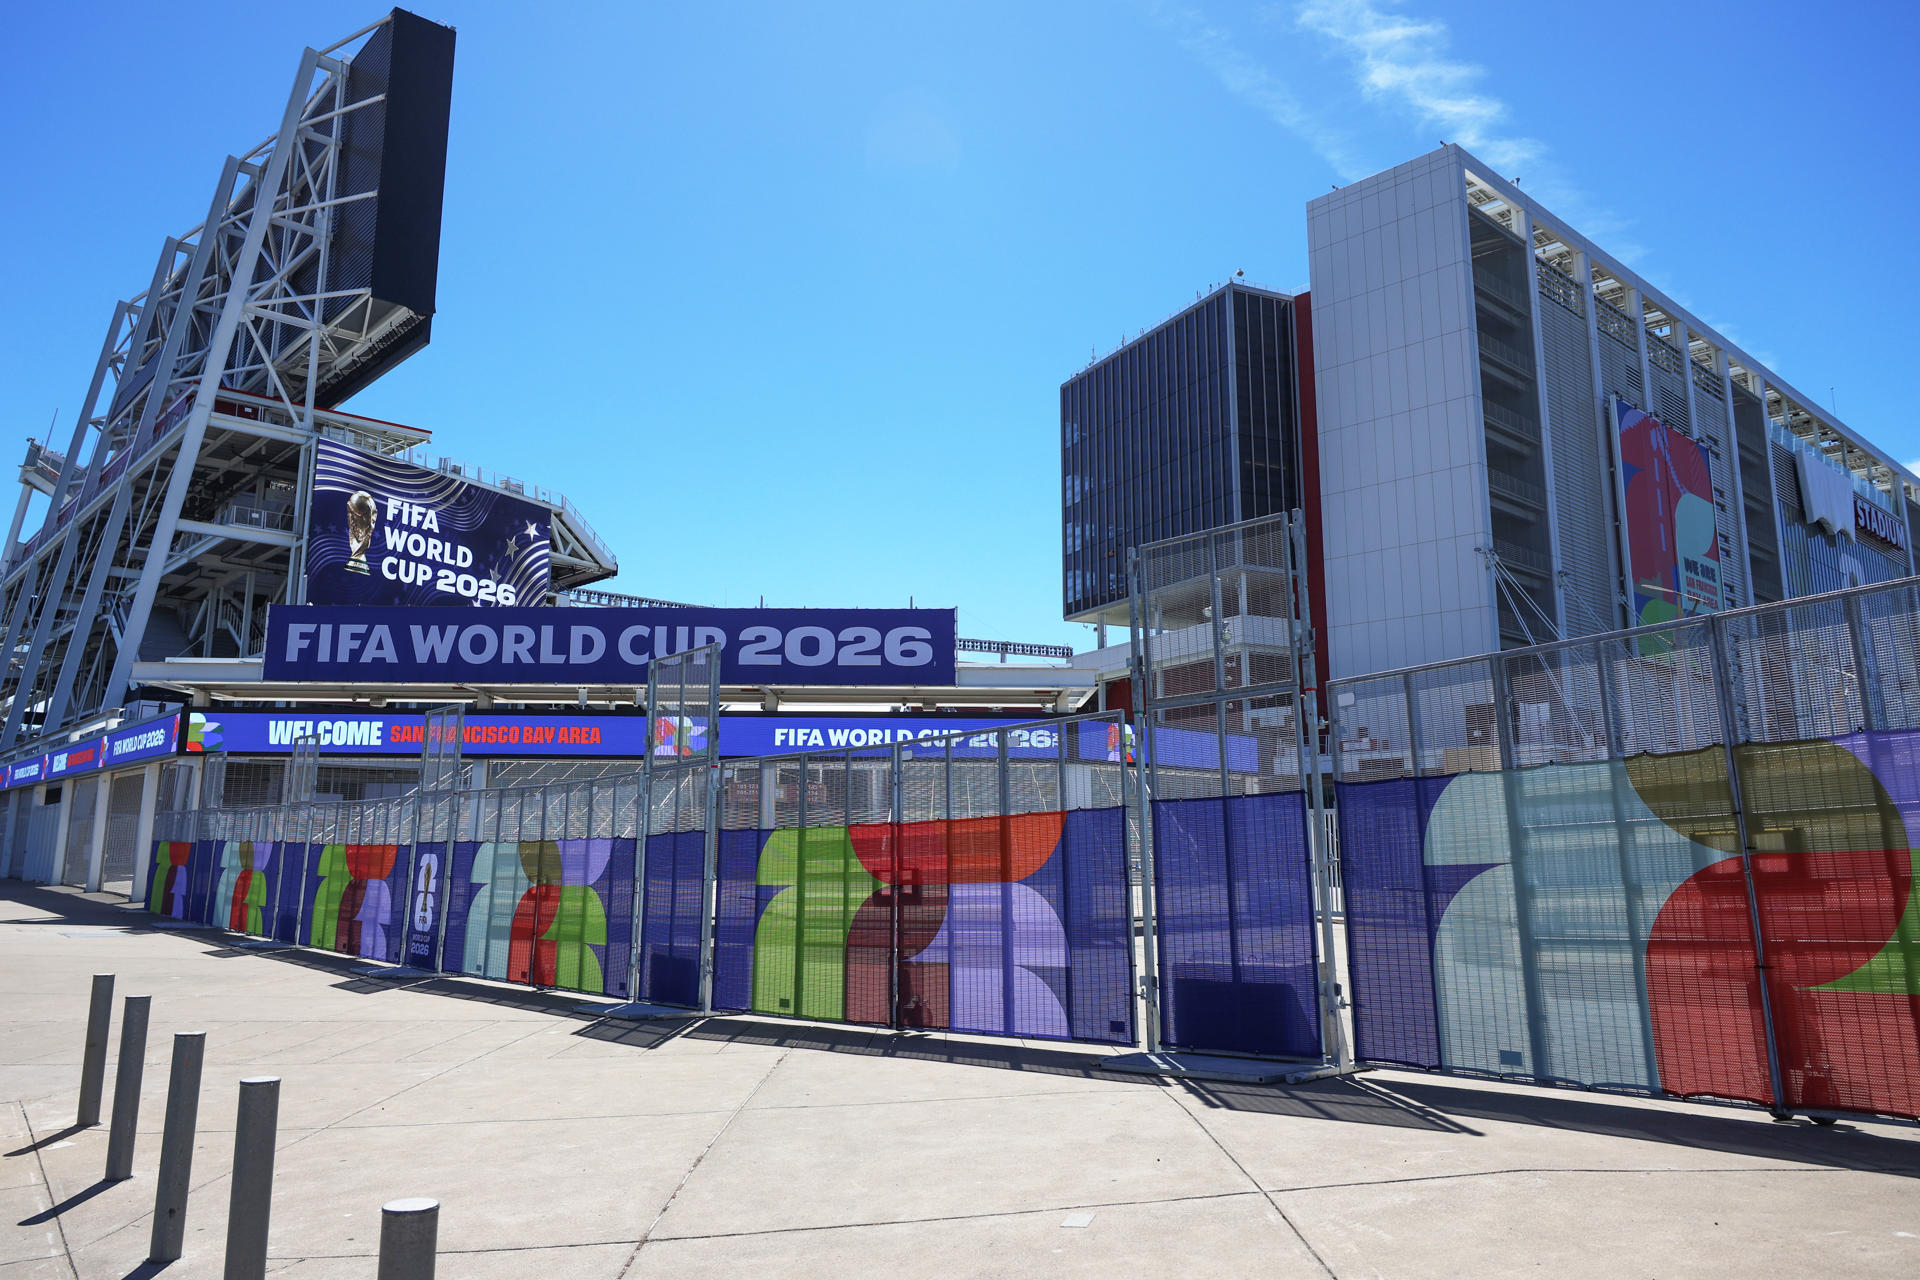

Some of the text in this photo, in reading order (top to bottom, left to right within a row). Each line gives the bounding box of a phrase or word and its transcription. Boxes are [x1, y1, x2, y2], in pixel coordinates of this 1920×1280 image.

[386, 497, 440, 533] FIFA
[1855, 500, 1907, 550] STADIUM
[384, 526, 473, 568] WORLD
[381, 556, 516, 606] CUP 2026
[1683, 556, 1699, 576] WE
[285, 623, 933, 667] FIFA WORLD CUP 2026
[122, 735, 138, 754] WORLD
[137, 733, 147, 750] CUP
[146, 728, 164, 748] 2026
[268, 720, 383, 746] WELCOME
[390, 725, 425, 743] SAN
[523, 726, 556, 744] BAY
[557, 727, 602, 745] AREA
[774, 728, 825, 746] FIFA
[828, 728, 914, 747] WORLD
[917, 729, 965, 748] CUP
[411, 942, 429, 955] 2026
